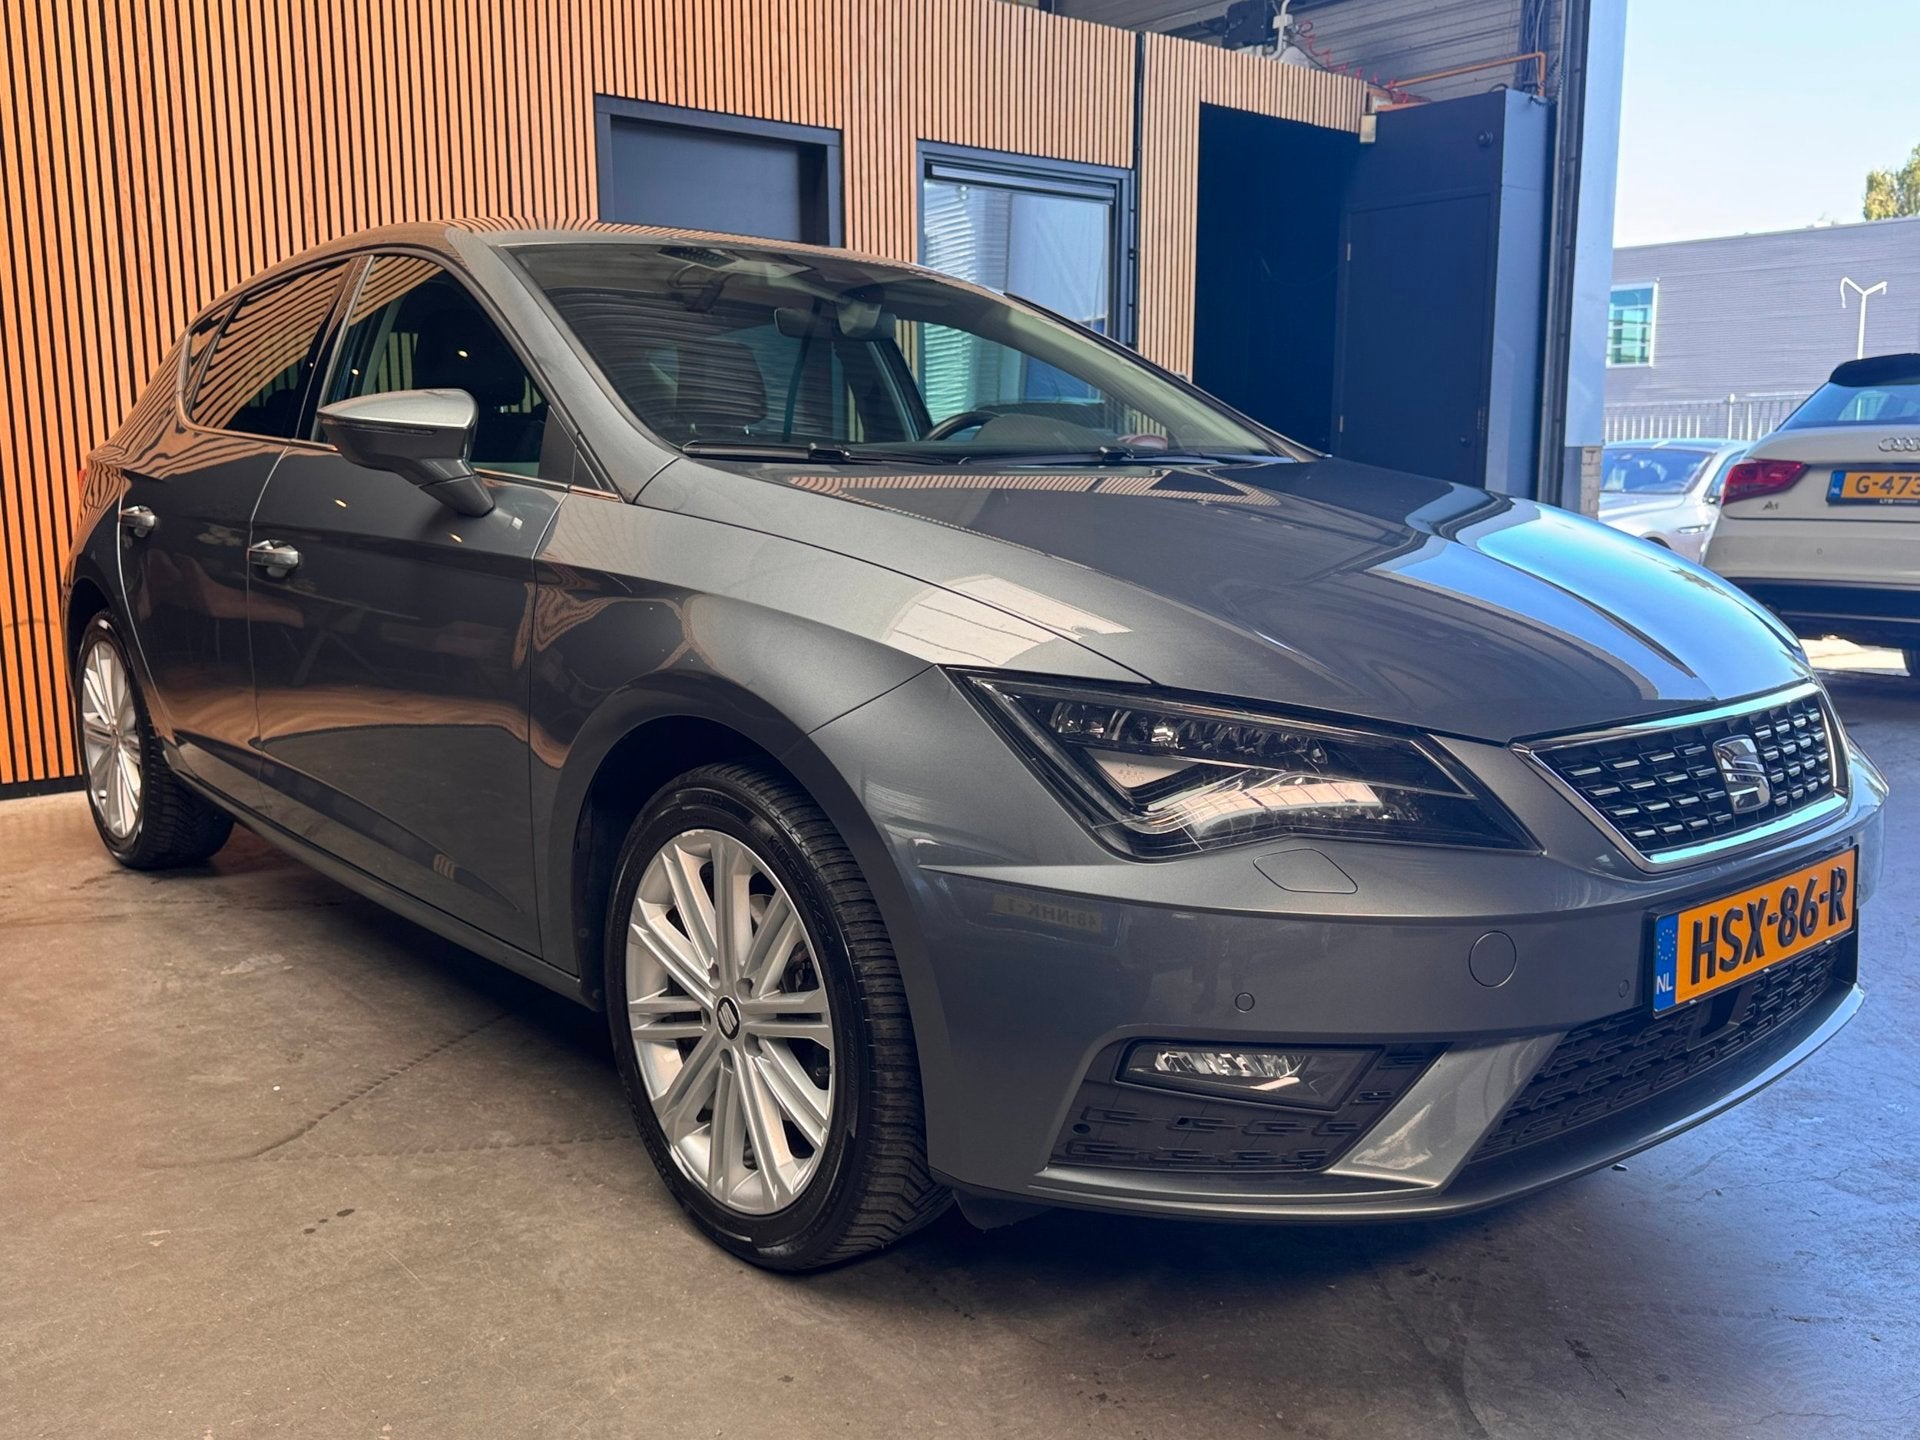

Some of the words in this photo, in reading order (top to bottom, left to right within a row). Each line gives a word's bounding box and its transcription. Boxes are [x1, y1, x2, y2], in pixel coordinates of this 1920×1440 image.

[1762, 500, 1779, 511] A1
[1690, 866, 1848, 986] HSX-86-R
[1656, 972, 1673, 995] NL
